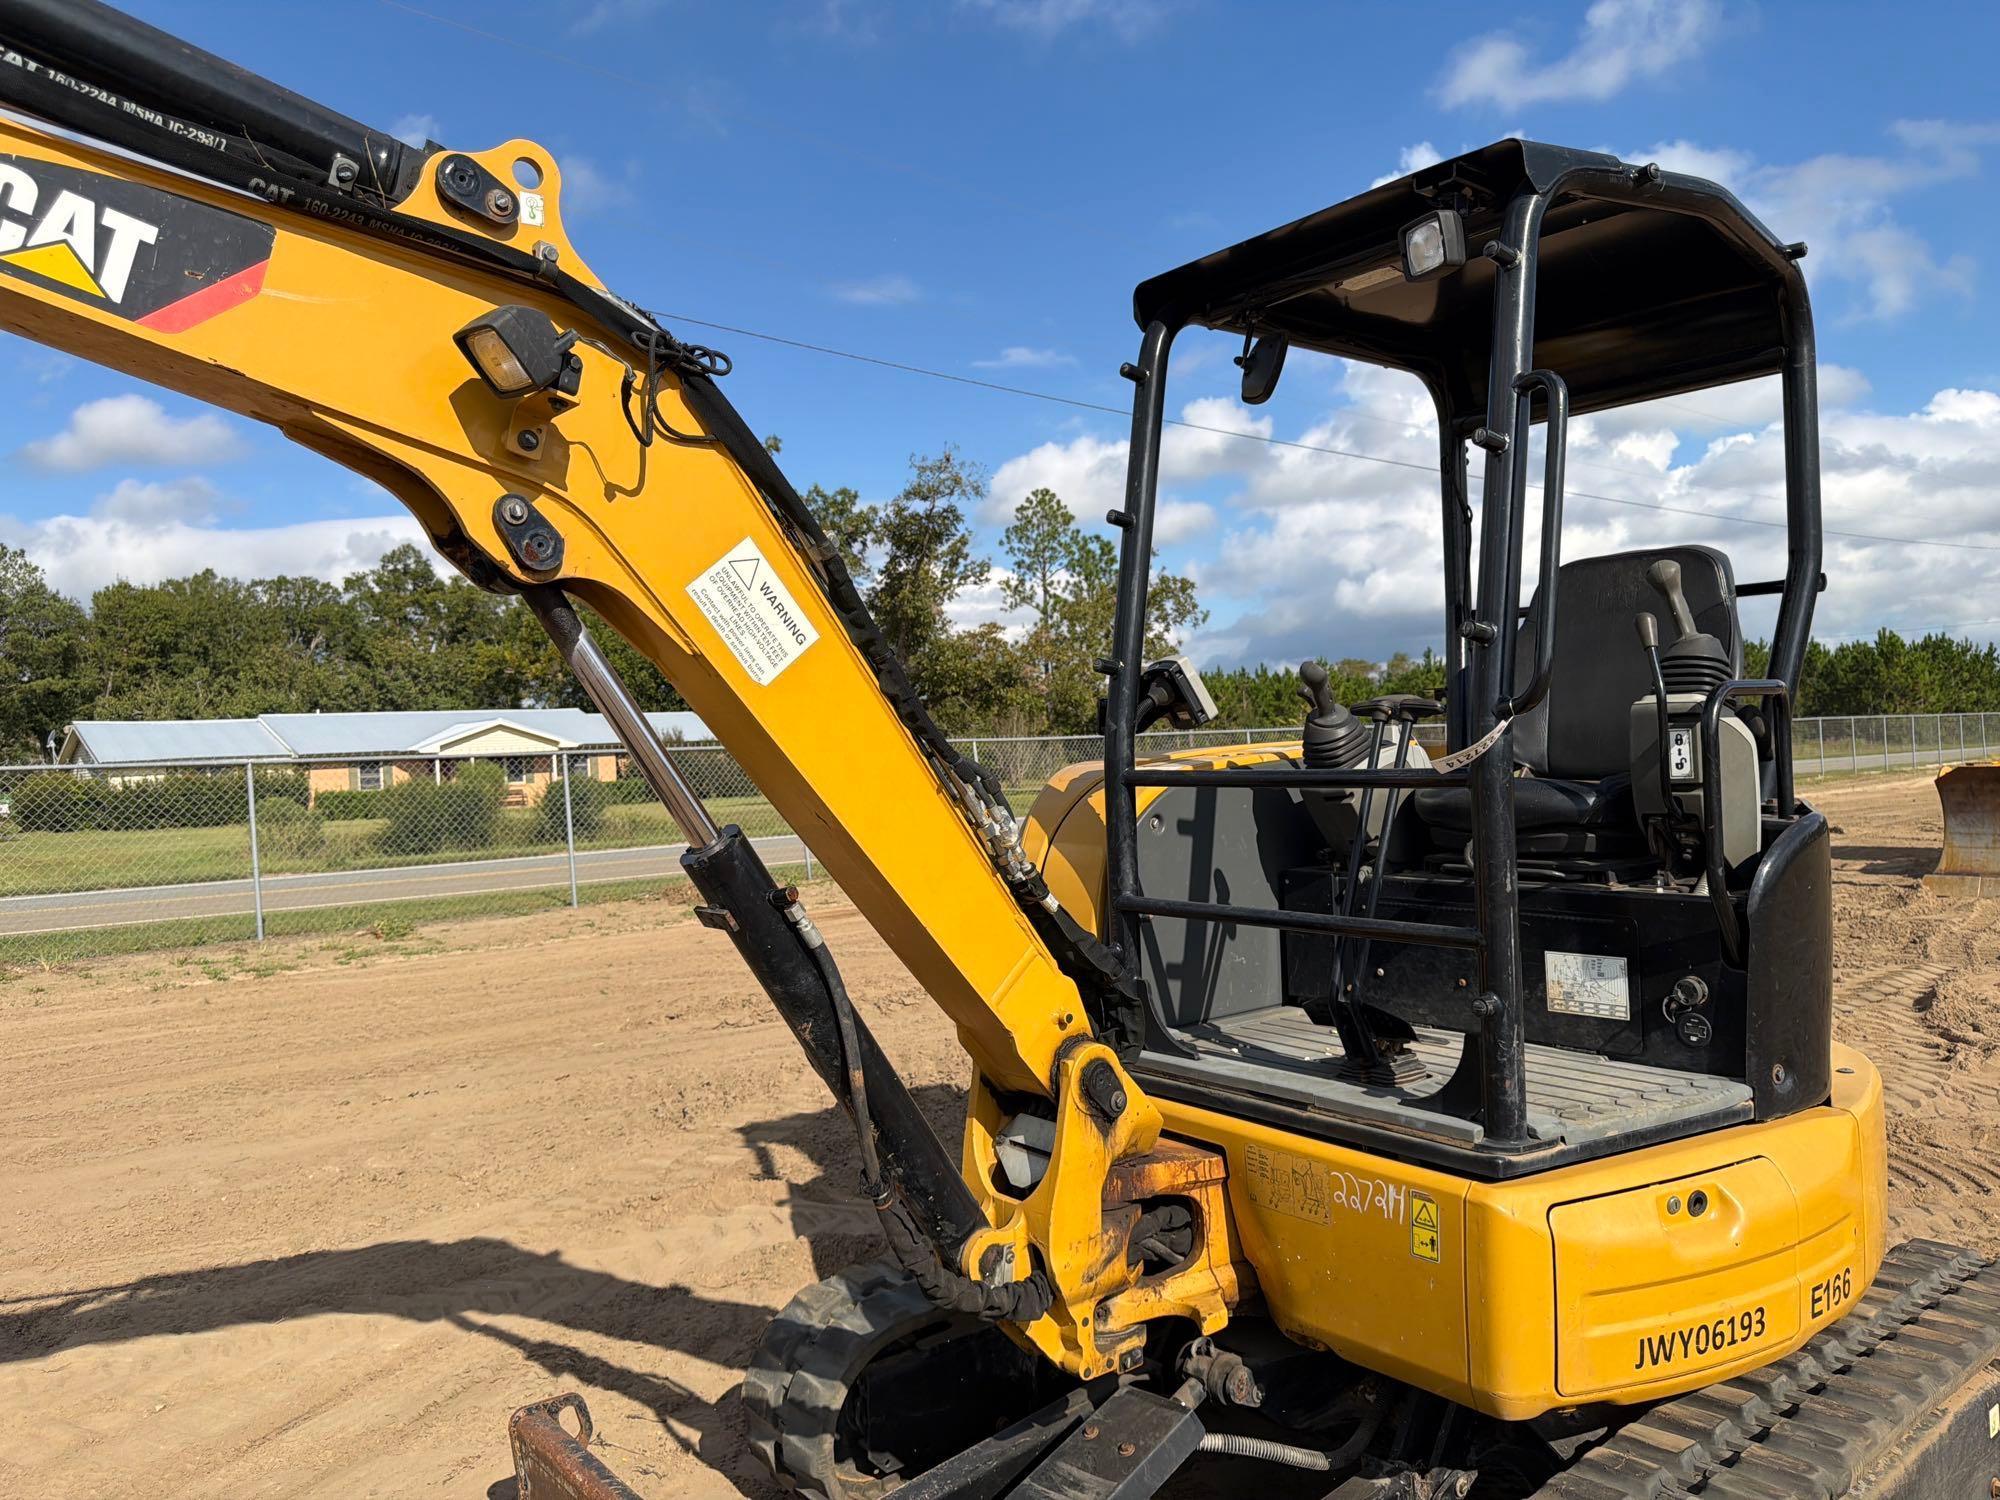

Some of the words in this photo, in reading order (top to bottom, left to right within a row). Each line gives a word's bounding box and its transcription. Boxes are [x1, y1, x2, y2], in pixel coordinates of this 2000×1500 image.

[249, 177, 296, 203] CAT
[0, 163, 159, 304] CAT
[691, 588, 707, 608] result
[710, 614, 726, 633] death
[700, 588, 721, 614] Contact
[719, 612, 731, 628] with
[728, 627, 745, 648] power
[743, 646, 756, 663] lines
[755, 662, 765, 675] can
[709, 574, 718, 586] OF
[716, 585, 746, 623] OVERHEAD
[742, 621, 779, 668] HIGH-VOLTAGE
[714, 570, 745, 610] EQUIPMENT
[743, 609, 762, 633] WITHIN
[760, 632, 771, 646] TEN
[769, 645, 783, 663] FEET
[721, 566, 749, 604] UNLAWFUL
[747, 602, 756, 613] TO
[754, 612, 777, 643] OPERATE
[776, 642, 788, 658] THIS
[759, 581, 807, 646] WARNING
[1446, 735, 1495, 769] 227214
[1811, 1267, 1851, 1319] E166
[1635, 1307, 1766, 1369] JWY06193
